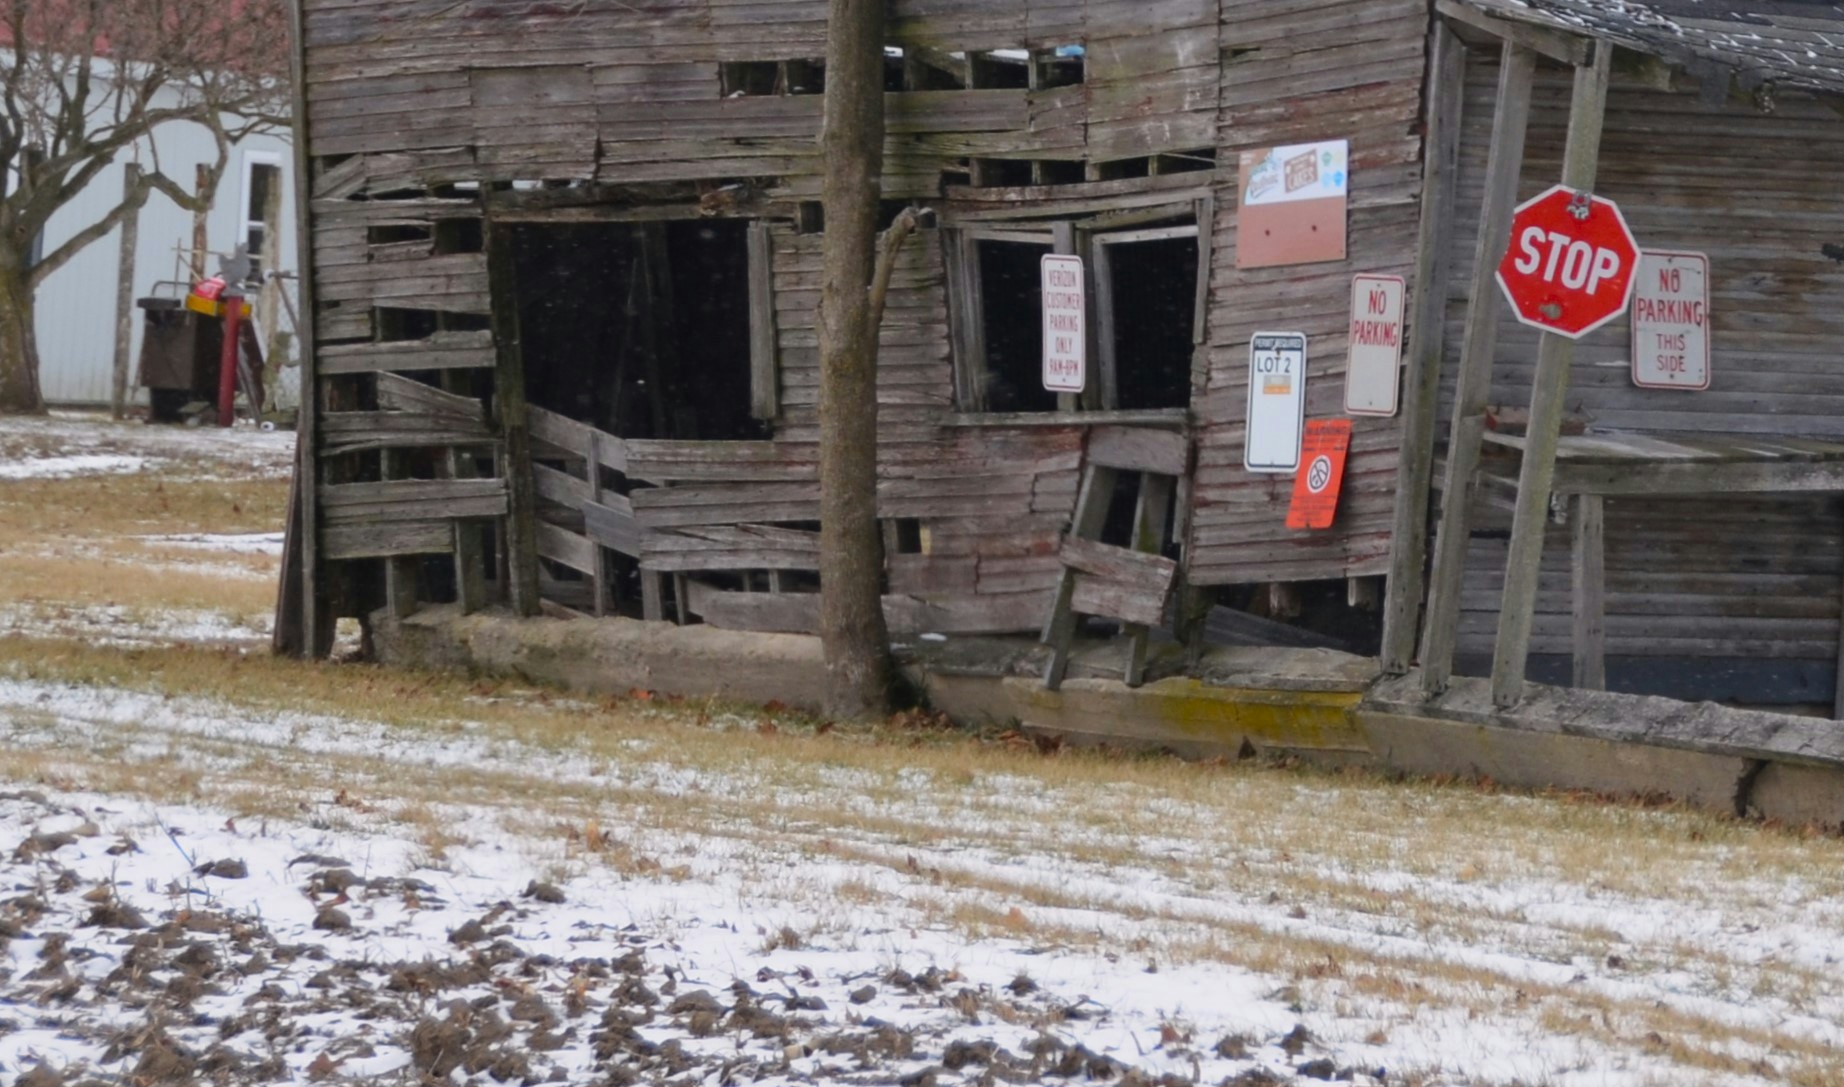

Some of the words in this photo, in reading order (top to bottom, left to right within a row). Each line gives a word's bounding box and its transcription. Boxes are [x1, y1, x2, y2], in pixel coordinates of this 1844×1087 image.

[1514, 226, 1620, 295] STOP
[1049, 270, 1076, 287] VERIZON
[1658, 268, 1680, 293] NO
[1046, 292, 1080, 309] CUSTOMER
[1368, 289, 1386, 315] NO
[1637, 298, 1703, 327] PARKING
[1049, 314, 1078, 332] PARKING
[1352, 320, 1397, 347] PARKING
[1656, 333, 1686, 351] THIS
[1056, 337, 1072, 353] ONLY
[1257, 357, 1281, 373] LOT
[1284, 357, 1291, 373] 2
[1657, 355, 1686, 372] SIDE
